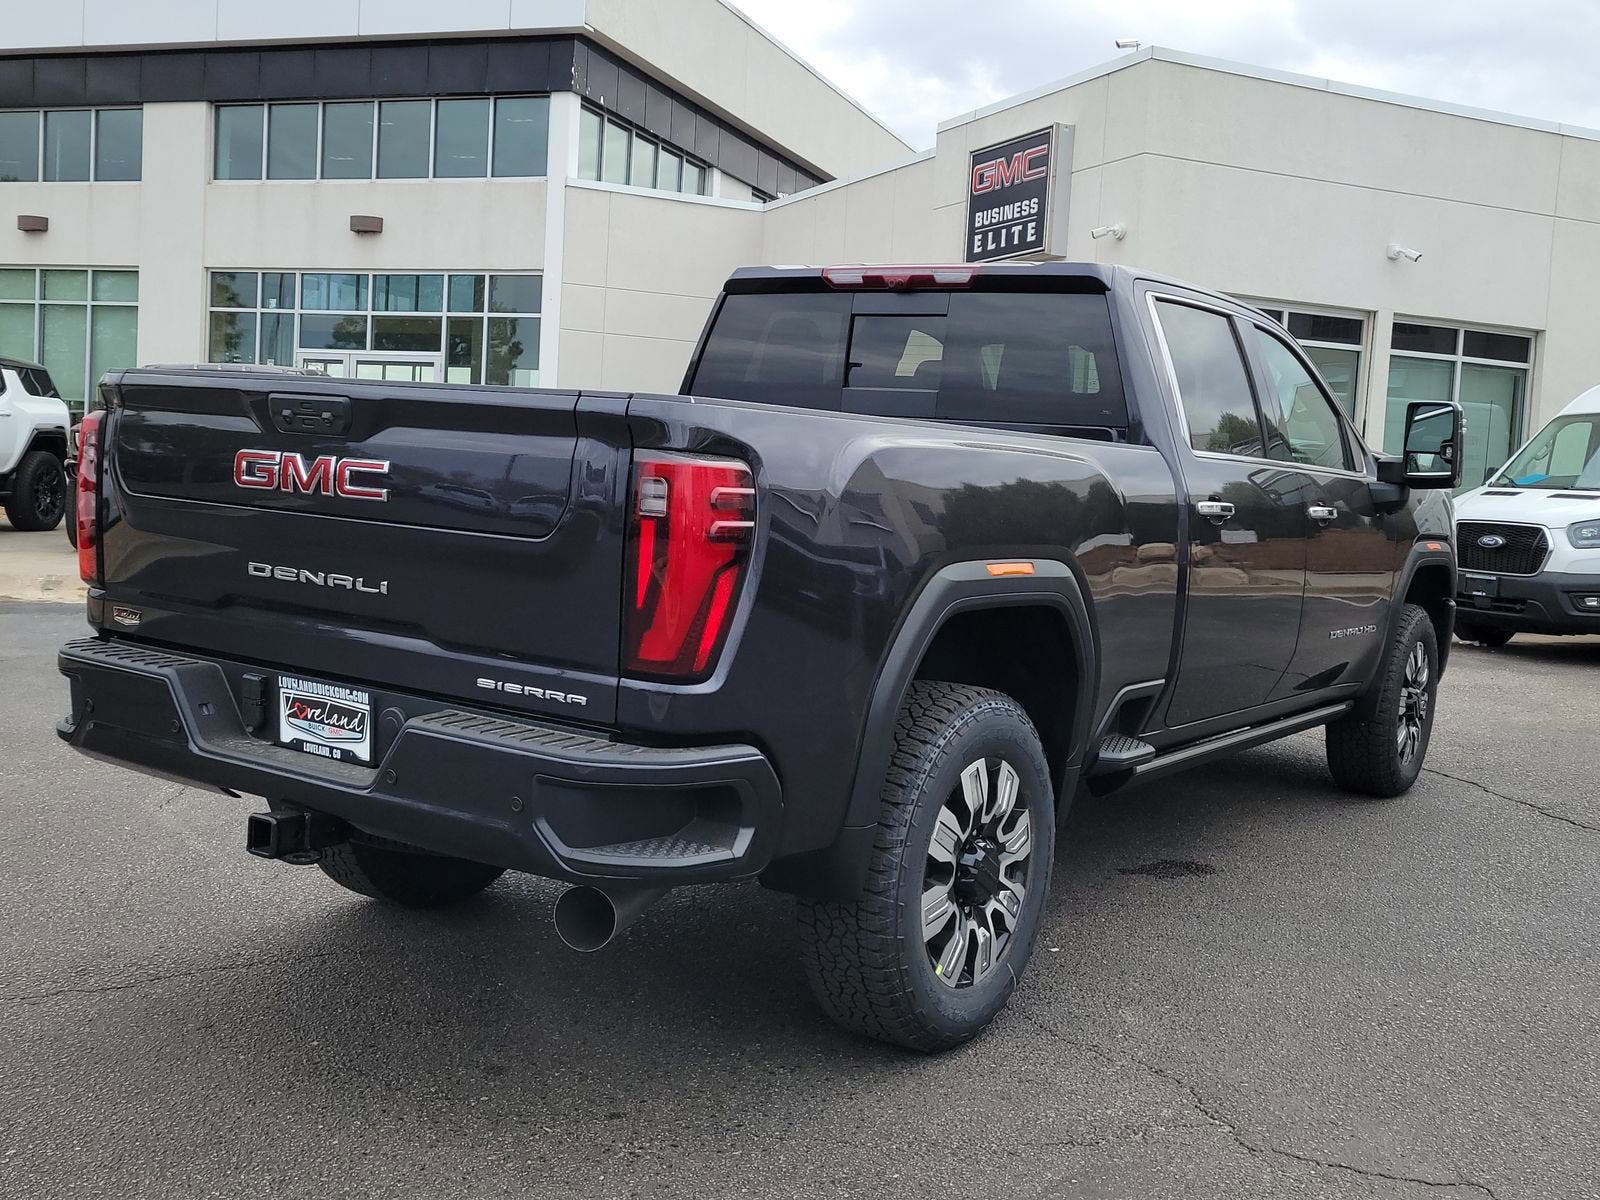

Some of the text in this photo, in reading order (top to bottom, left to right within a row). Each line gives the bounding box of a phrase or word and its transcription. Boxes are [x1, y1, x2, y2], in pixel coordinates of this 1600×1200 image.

[972, 143, 1049, 195] GMC
[974, 197, 1039, 228] BUSINESS
[973, 221, 1037, 254] ELITE
[233, 448, 391, 503] GMC
[247, 561, 389, 595] DENALI
[476, 677, 588, 706] SIERRA
[307, 722, 343, 737] BUICK GMC
[332, 748, 341, 759] CO
